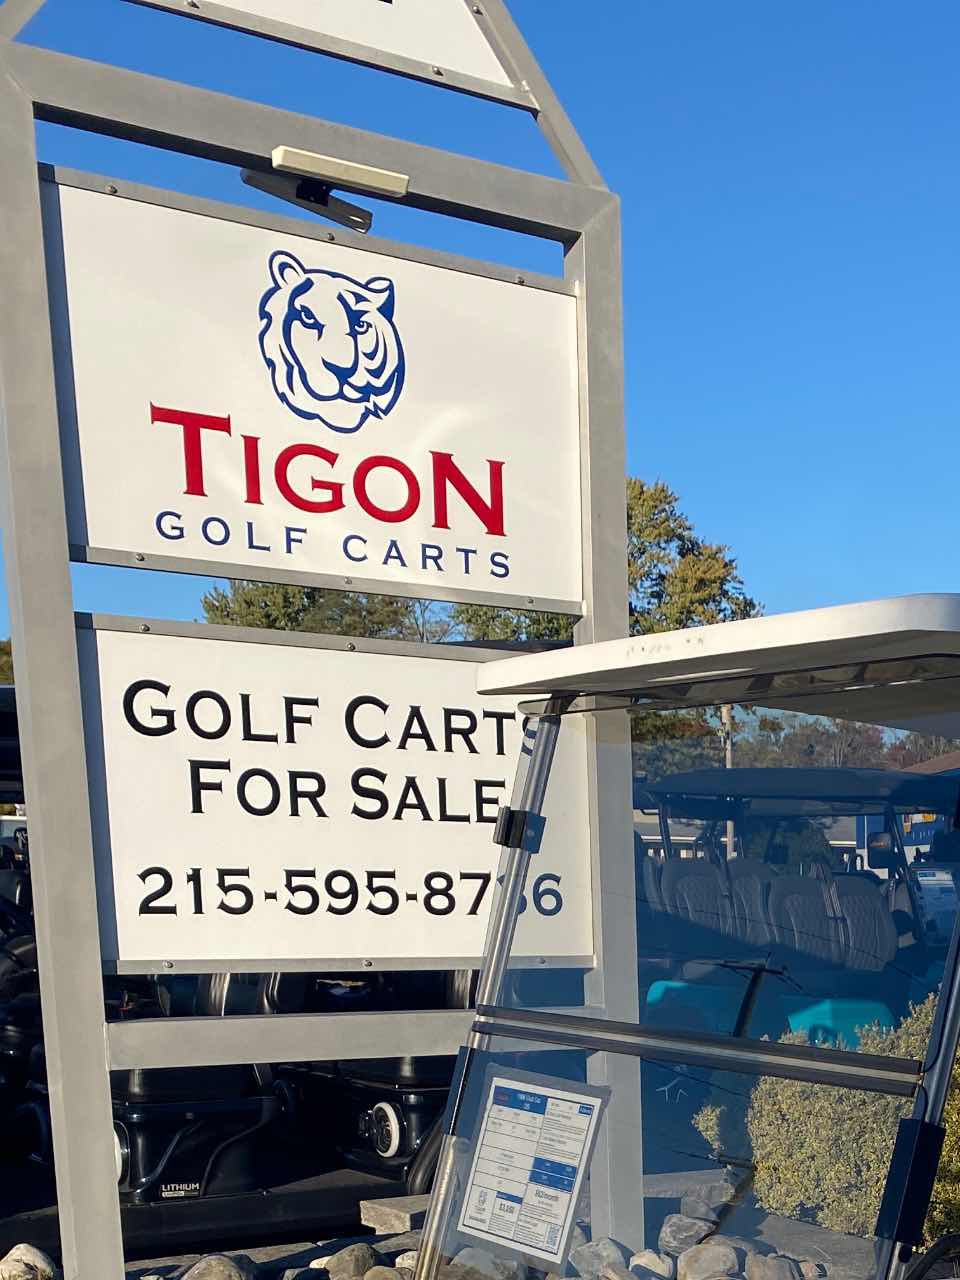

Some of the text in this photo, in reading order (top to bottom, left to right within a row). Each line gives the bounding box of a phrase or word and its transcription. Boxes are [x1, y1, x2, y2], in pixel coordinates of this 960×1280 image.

[150, 402, 507, 537] TIGON
[155, 510, 511, 578] GOLF CARTS
[122, 679, 320, 744] GOLF
[187, 759, 506, 824] FOR SALE
[161, 1182, 200, 1191] LITHIUM
